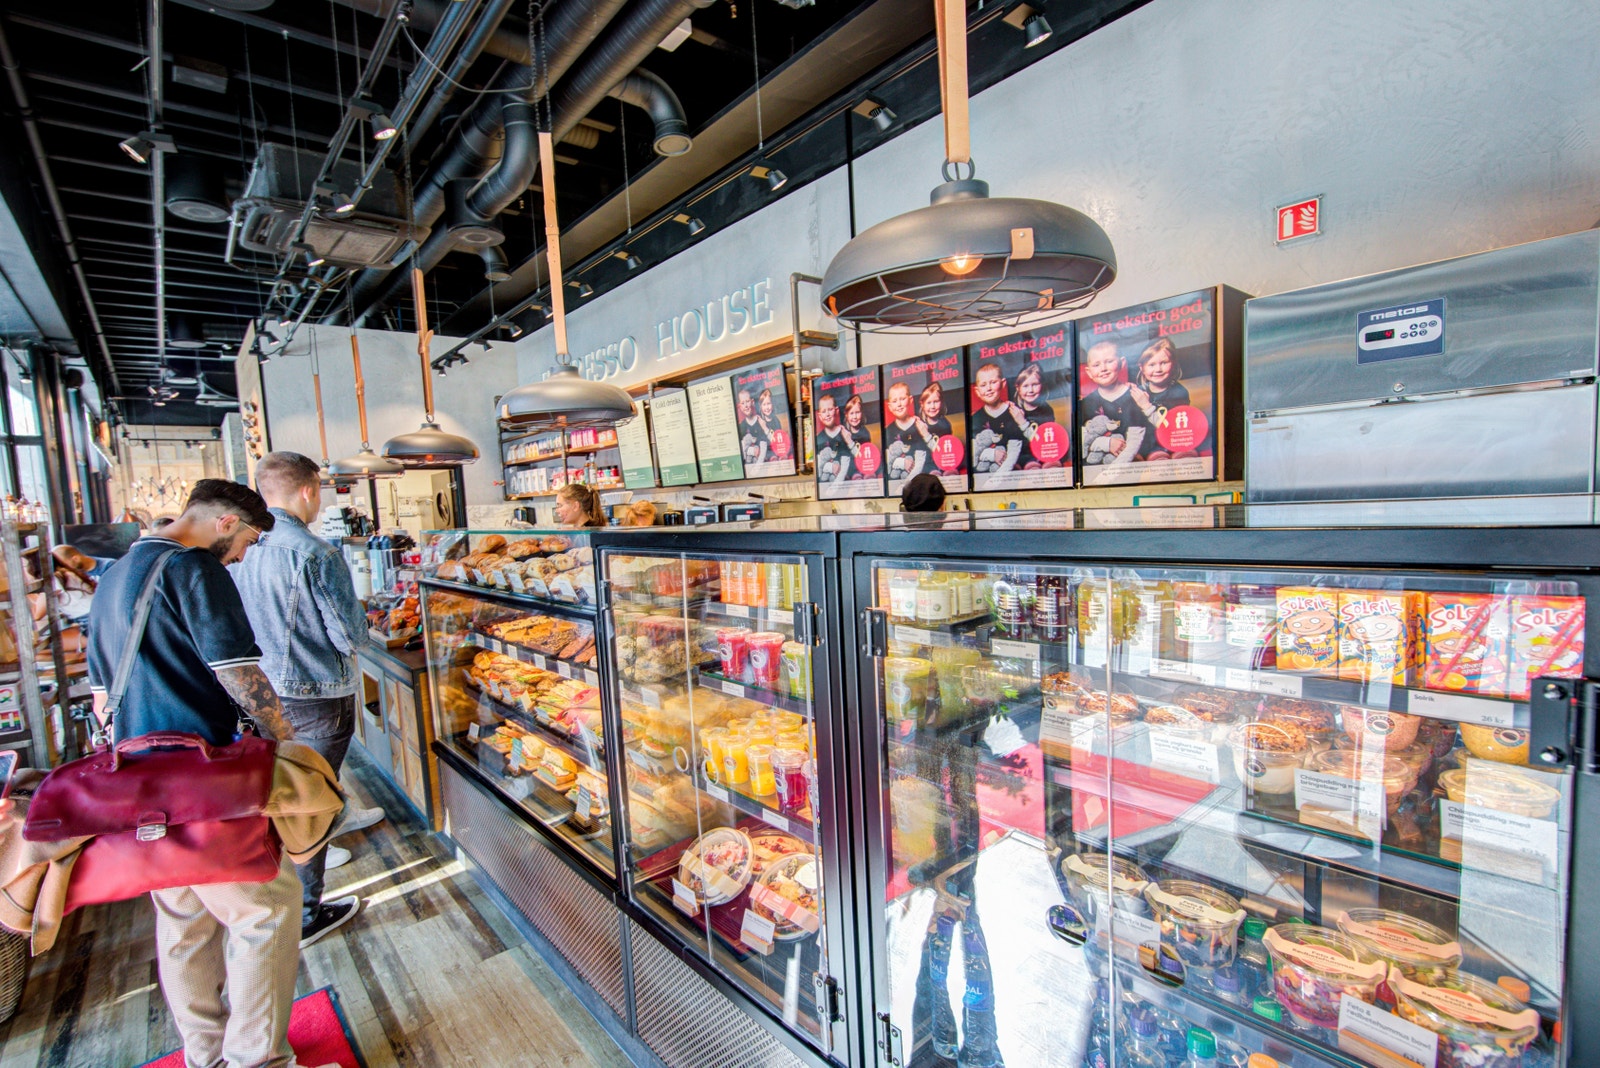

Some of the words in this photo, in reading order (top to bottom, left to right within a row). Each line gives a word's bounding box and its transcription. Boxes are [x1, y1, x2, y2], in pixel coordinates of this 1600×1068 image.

[654, 277, 774, 361] HOUSE
[1092, 322, 1113, 335] En
[1115, 310, 1166, 330] ekstra
[1170, 298, 1203, 322] god
[1370, 305, 1428, 321] metos
[1158, 317, 1203, 338] kaffe
[980, 346, 996, 359] En
[997, 339, 1037, 355] ekstra
[1039, 329, 1064, 349] god
[1030, 345, 1064, 362] kaffe
[891, 367, 904, 378] En
[905, 361, 937, 375] ekstra
[938, 353, 958, 370] god
[821, 381, 832, 391] En
[832, 377, 858, 388] ekstra
[859, 370, 875, 385] god
[931, 368, 959, 382] kaffe
[706, 384, 724, 395] drinks
[666, 398, 682, 407] drinks
[1414, 694, 1435, 703] Solrik
[1494, 716, 1505, 724] kr
[1300, 774, 1347, 789] Chiapudding
[1348, 784, 1366, 792] med
[1300, 780, 1339, 791] bringebær
[1448, 806, 1507, 825] Chiapudding
[1509, 820, 1532, 829] med
[1448, 812, 1481, 824] mango
[1347, 1001, 1364, 1014] Feta
[1365, 1009, 1372, 1017] &
[1410, 1036, 1432, 1051] bowl
